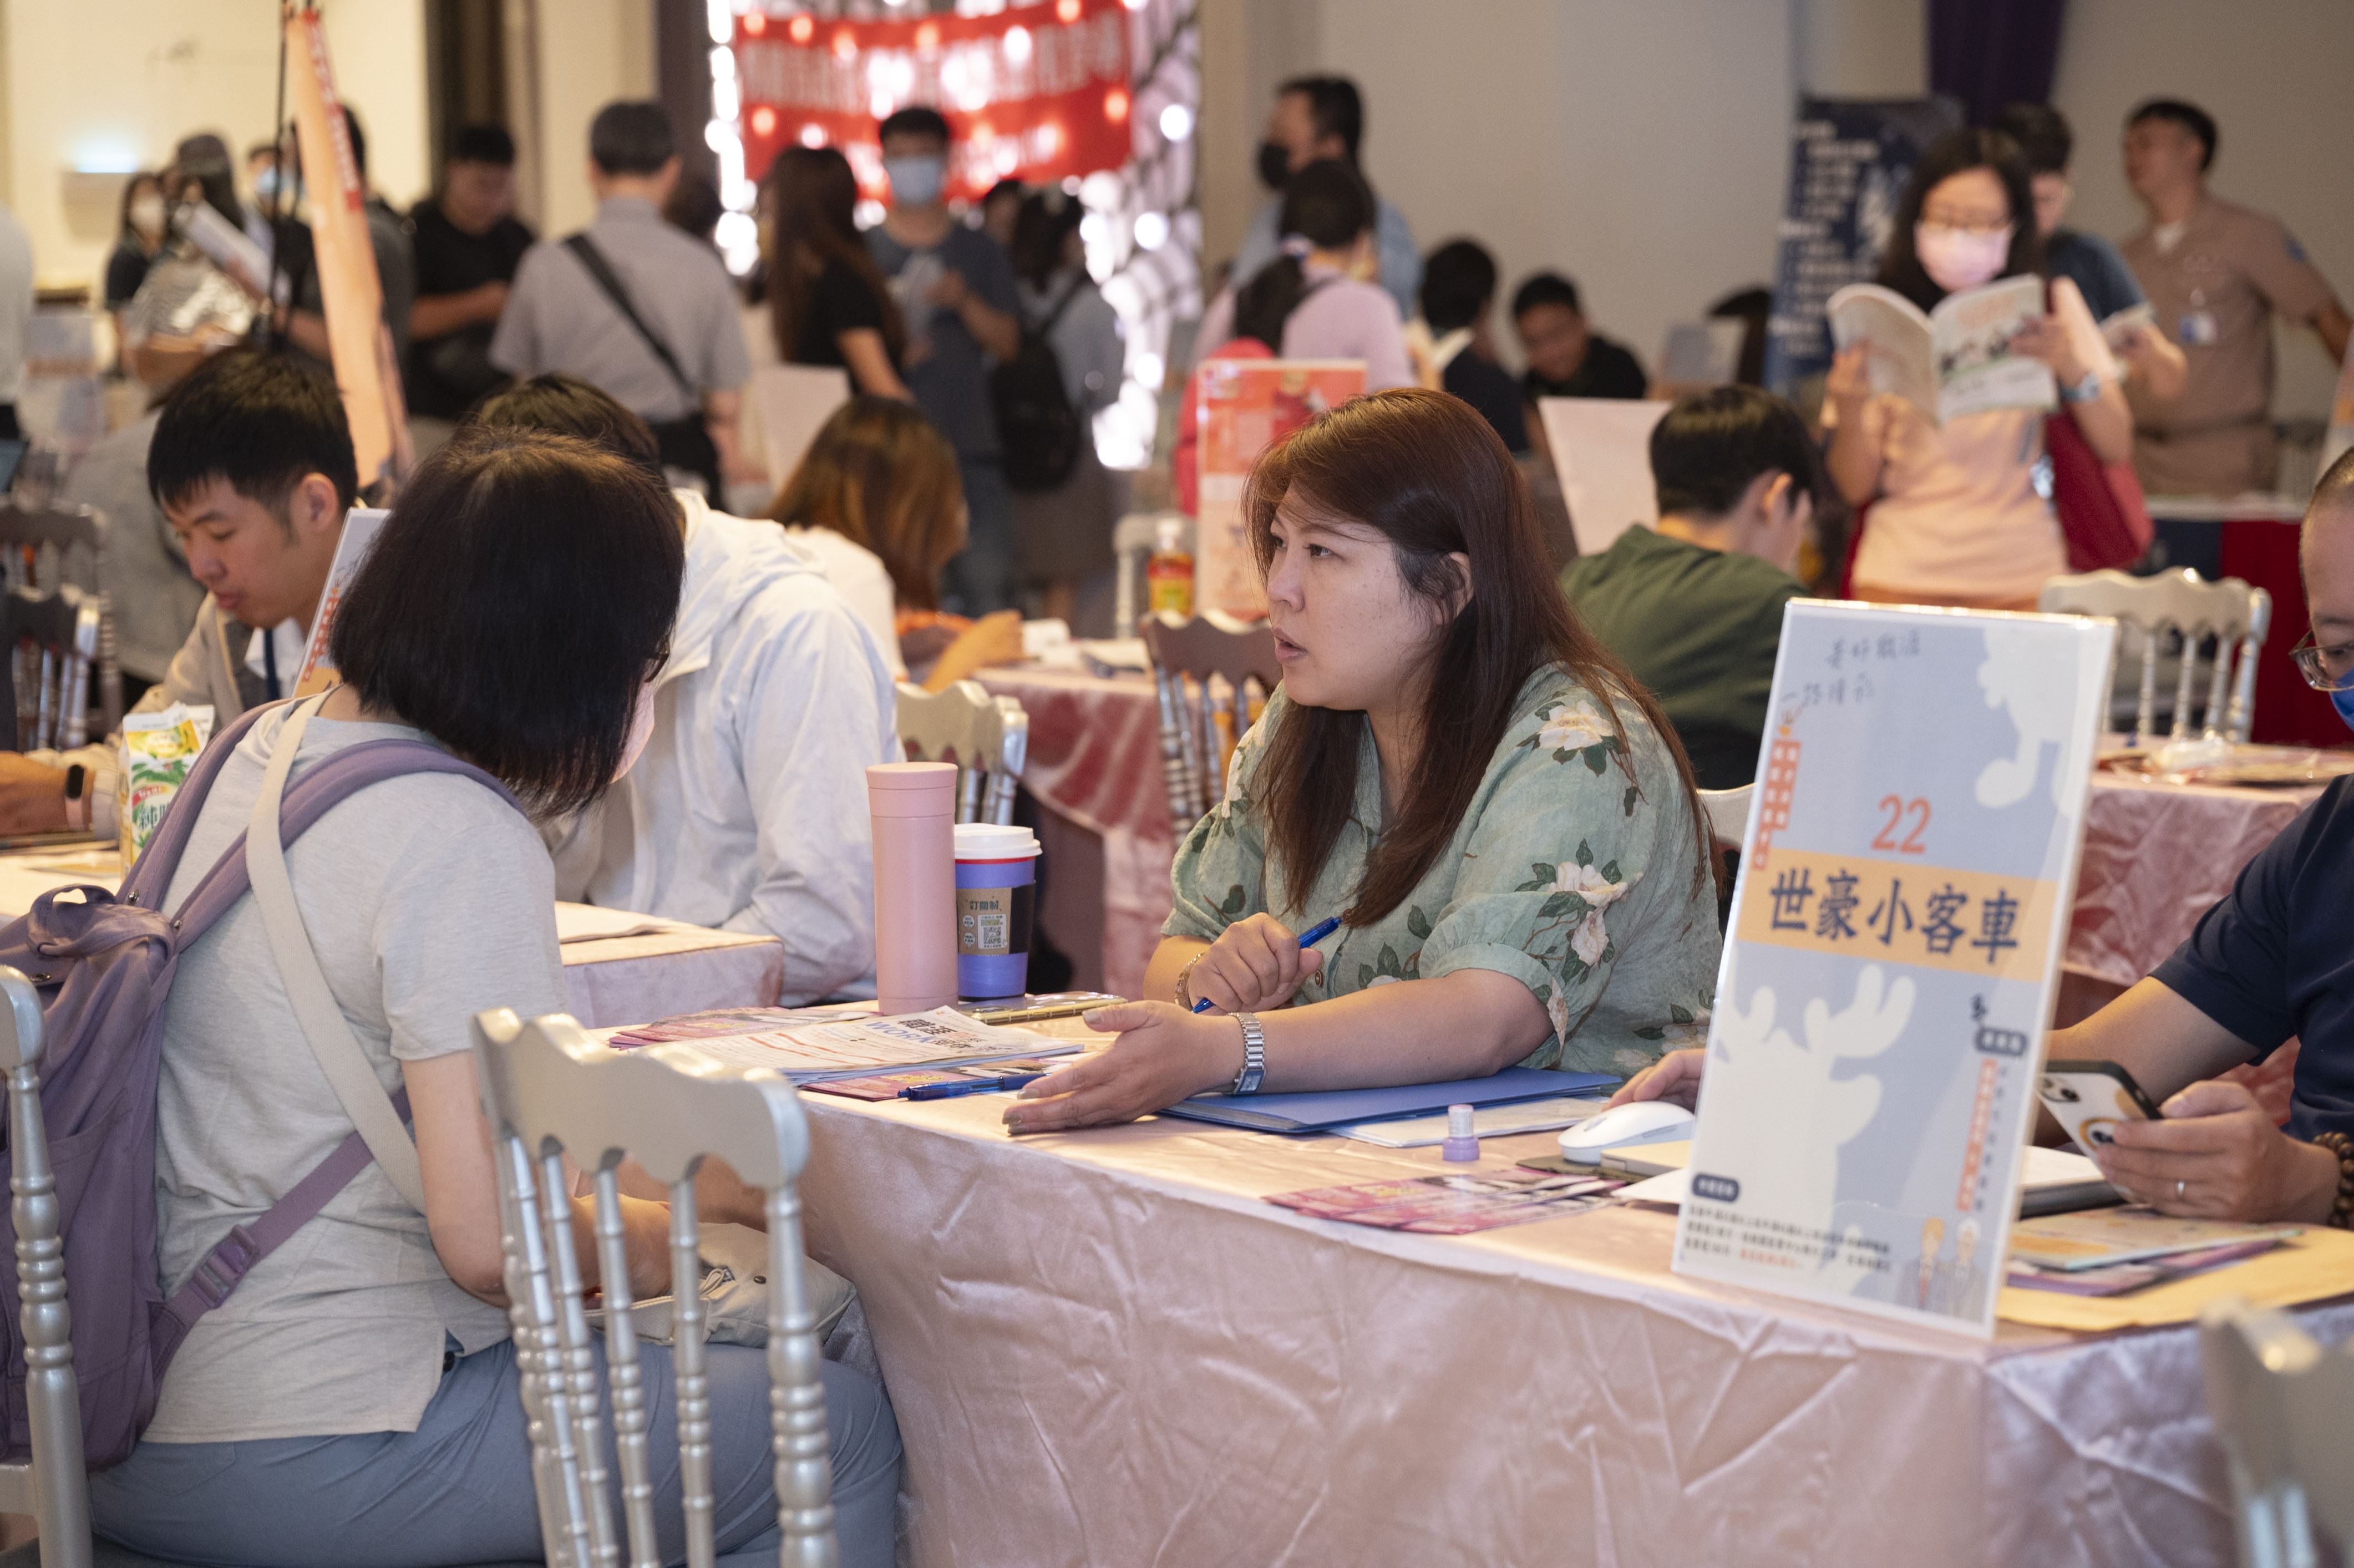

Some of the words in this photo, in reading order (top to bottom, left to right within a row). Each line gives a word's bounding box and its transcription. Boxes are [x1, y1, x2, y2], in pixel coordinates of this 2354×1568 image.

[1871, 793, 1933, 854] 22
[1769, 867, 2019, 965] 世豪小客車
[865, 1021, 937, 1044] WORK
